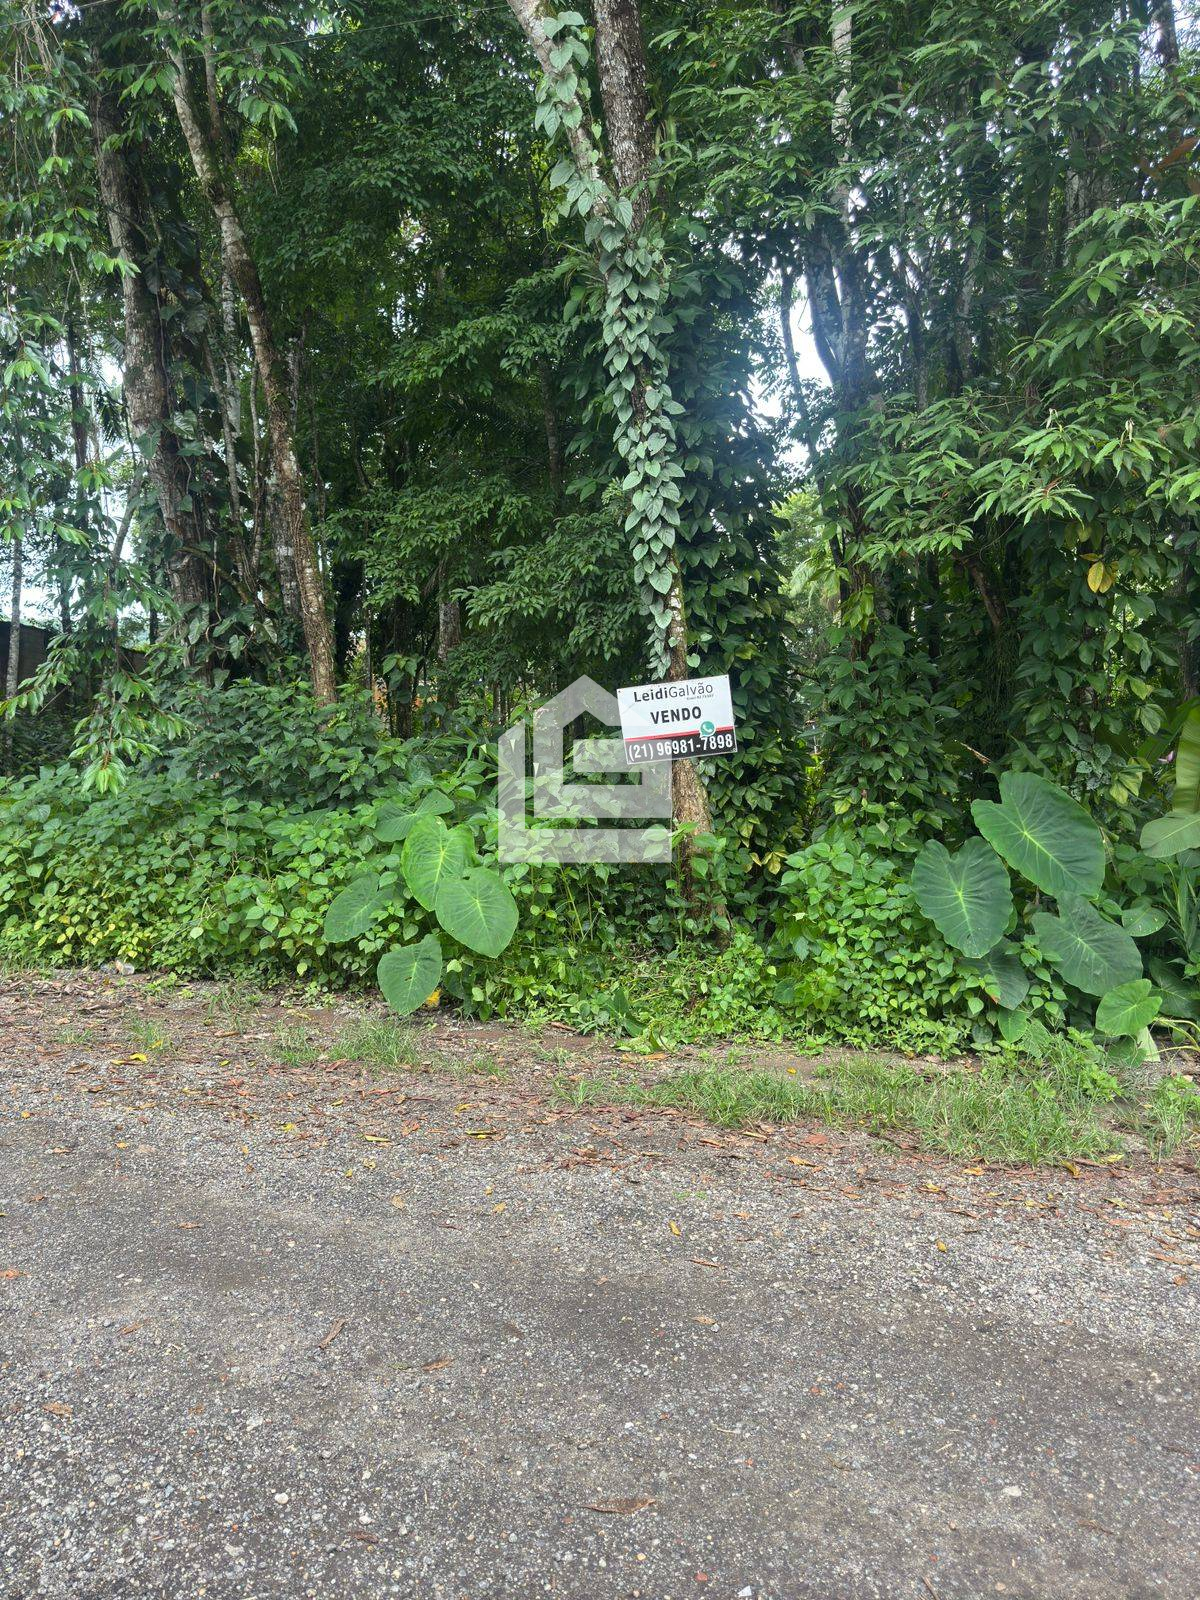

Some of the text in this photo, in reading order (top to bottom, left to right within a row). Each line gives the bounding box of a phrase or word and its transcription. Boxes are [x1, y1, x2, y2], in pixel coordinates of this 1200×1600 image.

[633, 682, 714, 703] LeidiGalvão
[650, 706, 702, 725] VENDO
[628, 733, 733, 762] (21) 96981-7898
